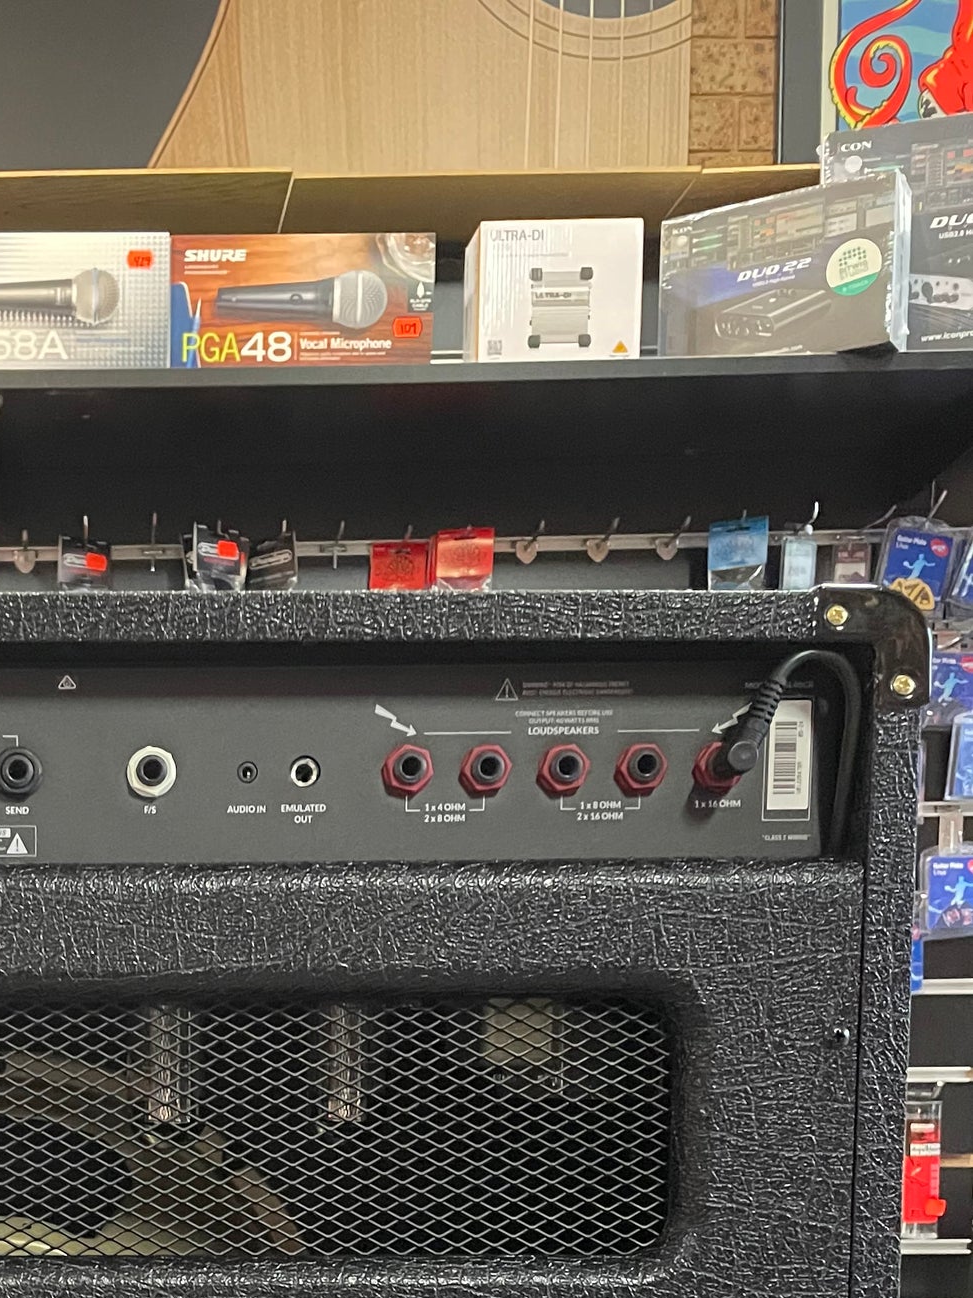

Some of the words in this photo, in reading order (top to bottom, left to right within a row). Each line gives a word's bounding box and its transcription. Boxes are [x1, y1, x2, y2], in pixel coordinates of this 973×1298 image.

[489, 229, 545, 242] ULTRA-DI
[184, 249, 247, 262] SHURE
[736, 264, 781, 283] DUO
[778, 257, 812, 272] 22
[181, 330, 293, 363] PGA48
[299, 337, 329, 350] Vocal
[330, 337, 393, 353] Microphone
[527, 726, 600, 736] LOUDSPEAKERS
[280, 803, 327, 813] EMULATED
[444, 804, 466, 812] OHM
[599, 801, 622, 809] OHM
[708, 799, 718, 808] 16
[719, 799, 742, 808] OHM
[5, 806, 29, 815] SEND
[143, 805, 157, 815] F/S
[227, 804, 256, 814] AUDIO
[257, 804, 266, 814] IN
[293, 814, 313, 824] OUT
[444, 814, 466, 823] OHM
[591, 812, 600, 820] 16
[601, 812, 624, 820] OHM
